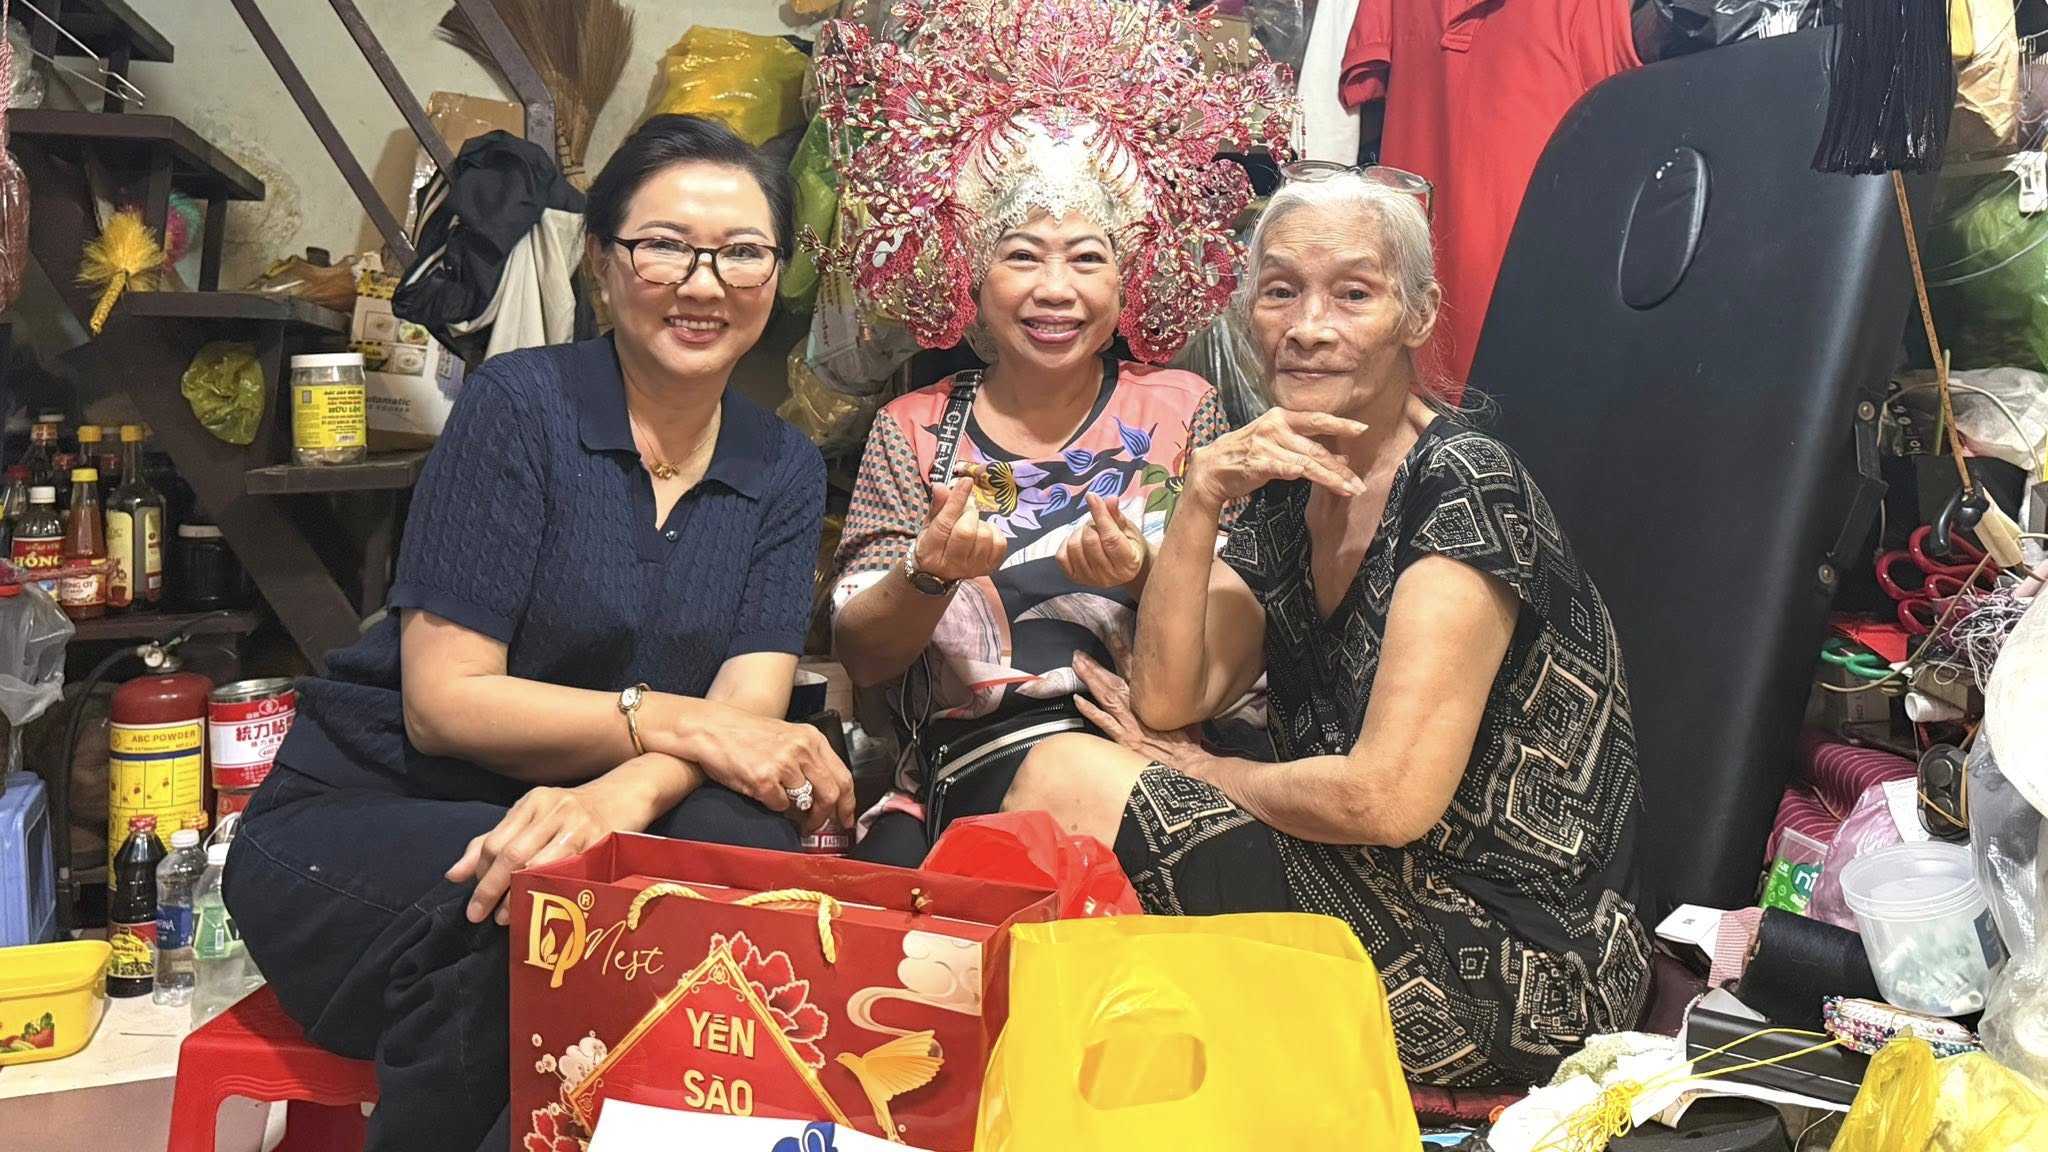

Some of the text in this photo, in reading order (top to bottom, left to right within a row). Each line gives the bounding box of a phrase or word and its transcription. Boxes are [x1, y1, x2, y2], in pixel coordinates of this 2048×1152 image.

[131, 730, 196, 743] ABC POWDER
[584, 919, 664, 981] Nest
[683, 1069, 753, 1116] SÀO
